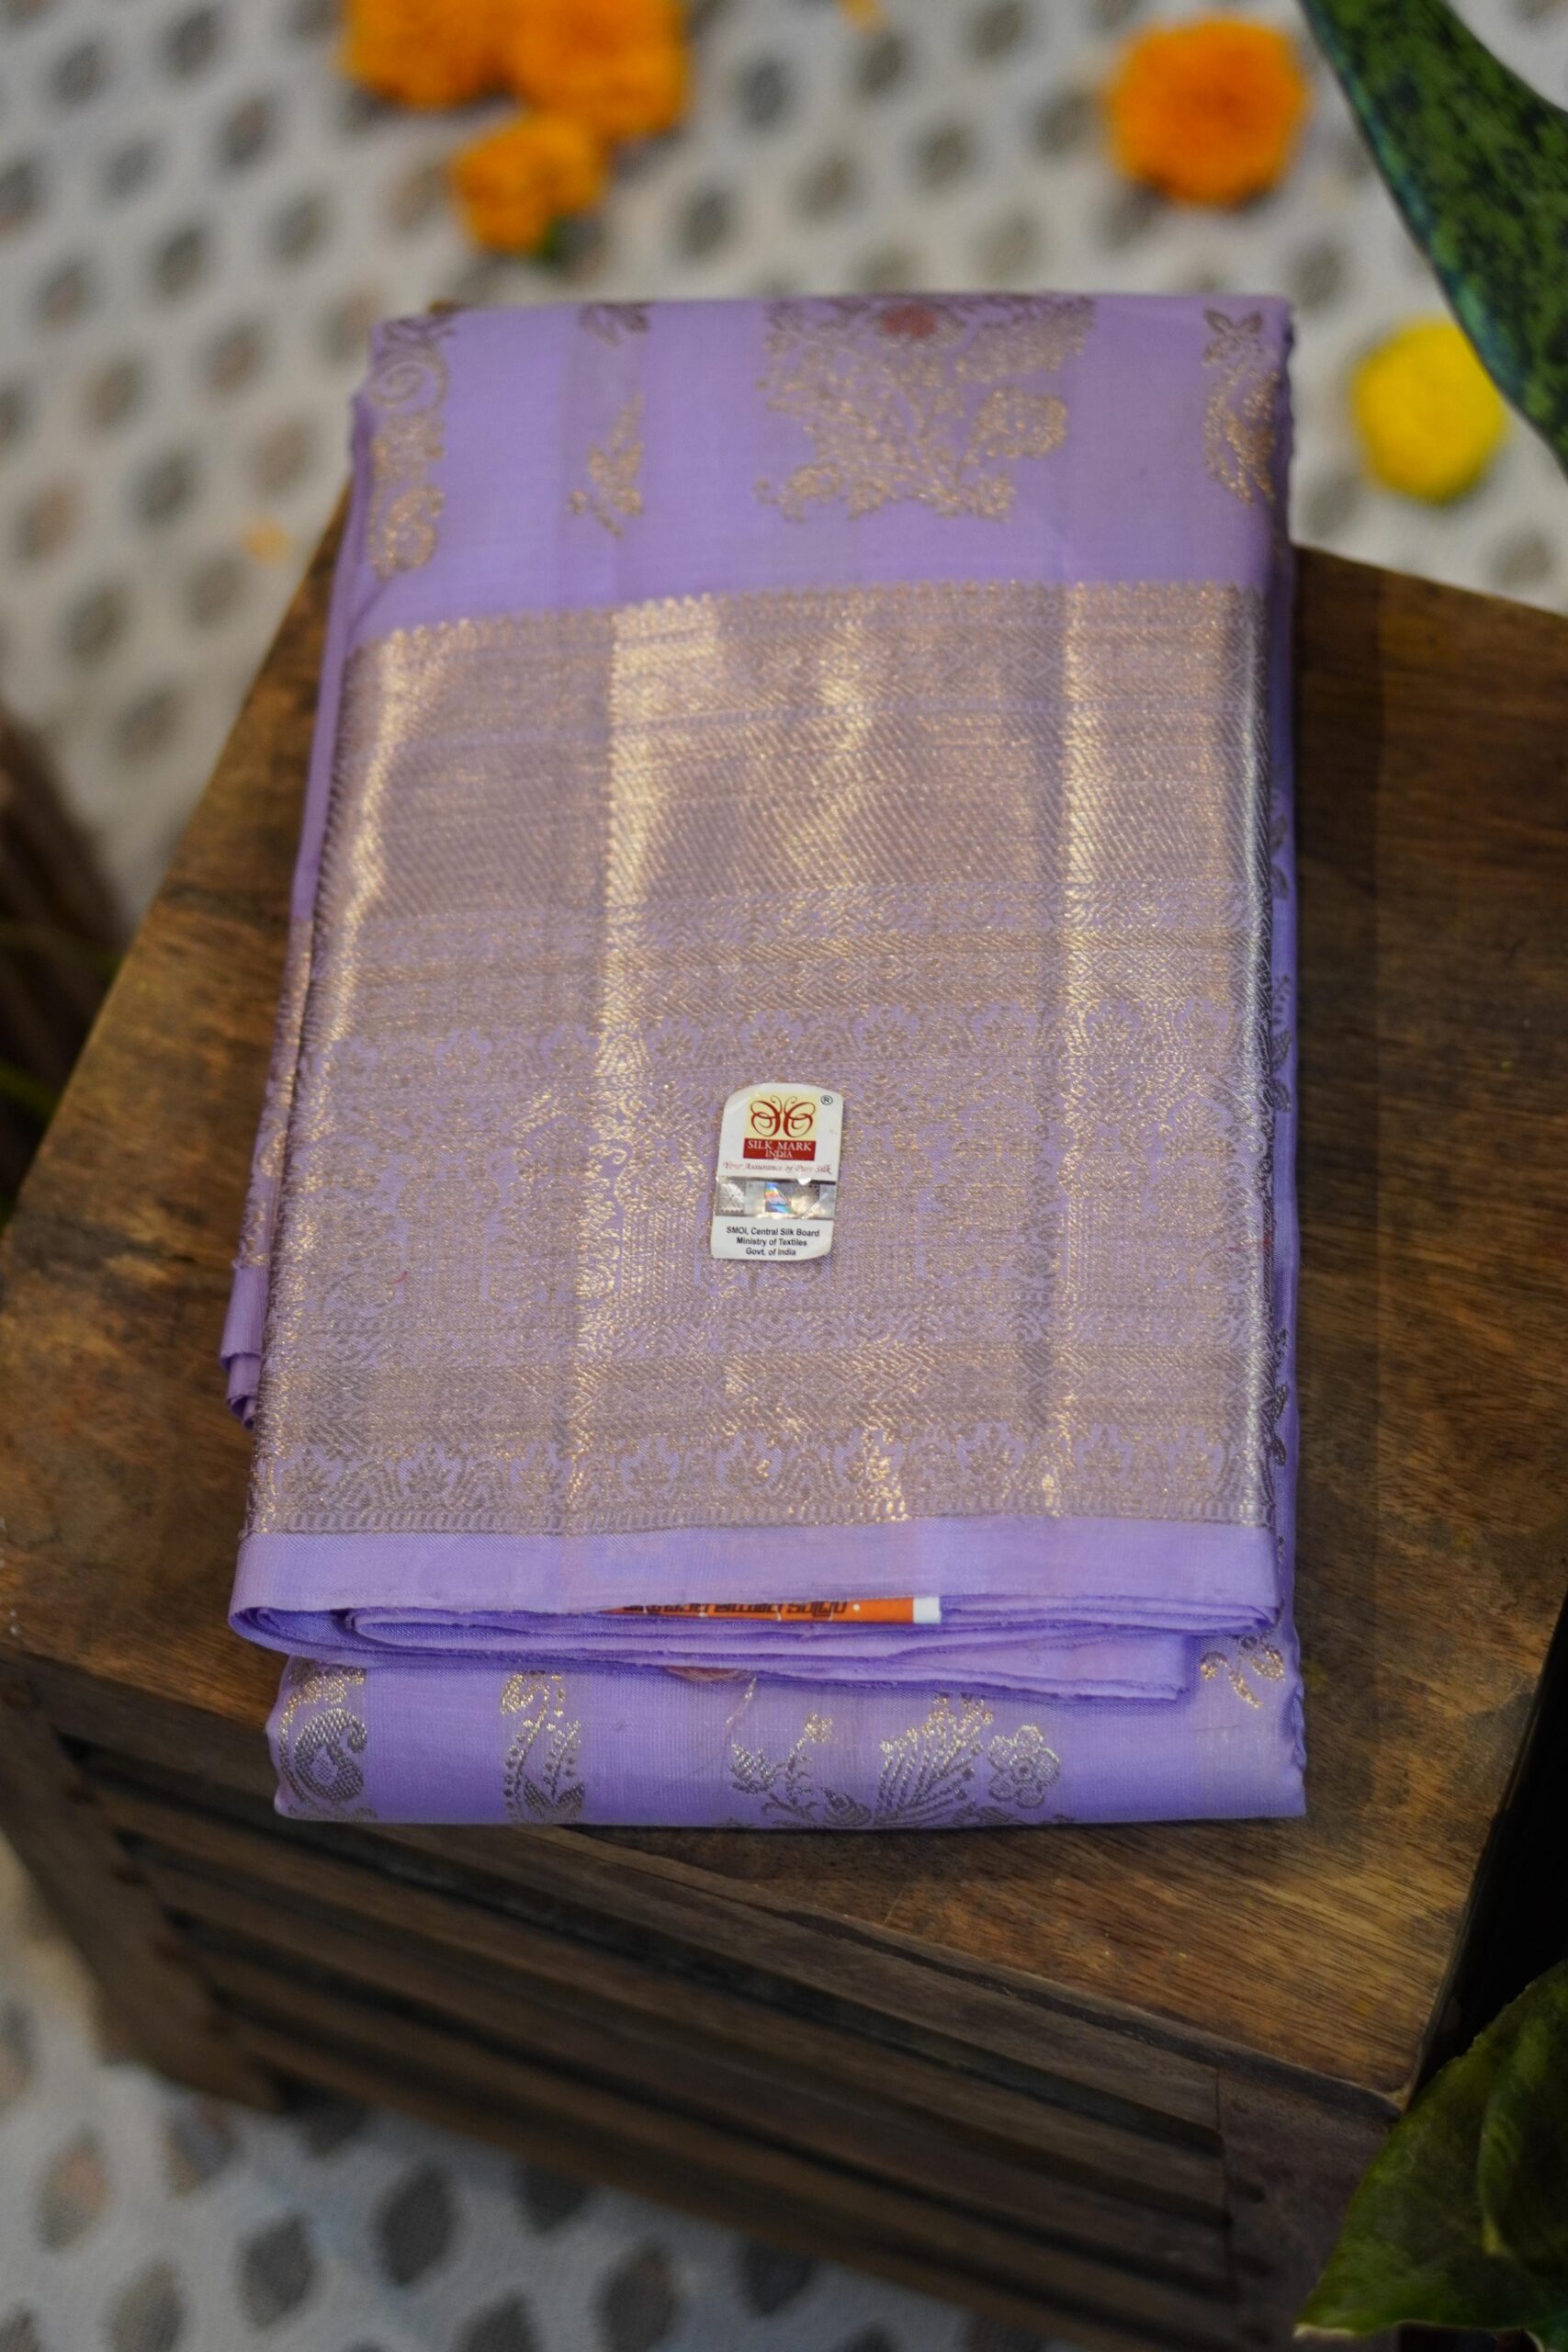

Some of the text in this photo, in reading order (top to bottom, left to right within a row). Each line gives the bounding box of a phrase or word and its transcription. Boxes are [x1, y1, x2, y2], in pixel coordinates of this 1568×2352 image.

[748, 1139, 812, 1152] SILK MARK
[764, 1149, 793, 1159] INDIA
[750, 1227, 779, 1236] Central
[780, 1227, 795, 1237] Silk
[796, 1228, 820, 1238] Board
[736, 1237, 807, 1247] Ministry of Textiles
[745, 1247, 796, 1256] Govt. of India
